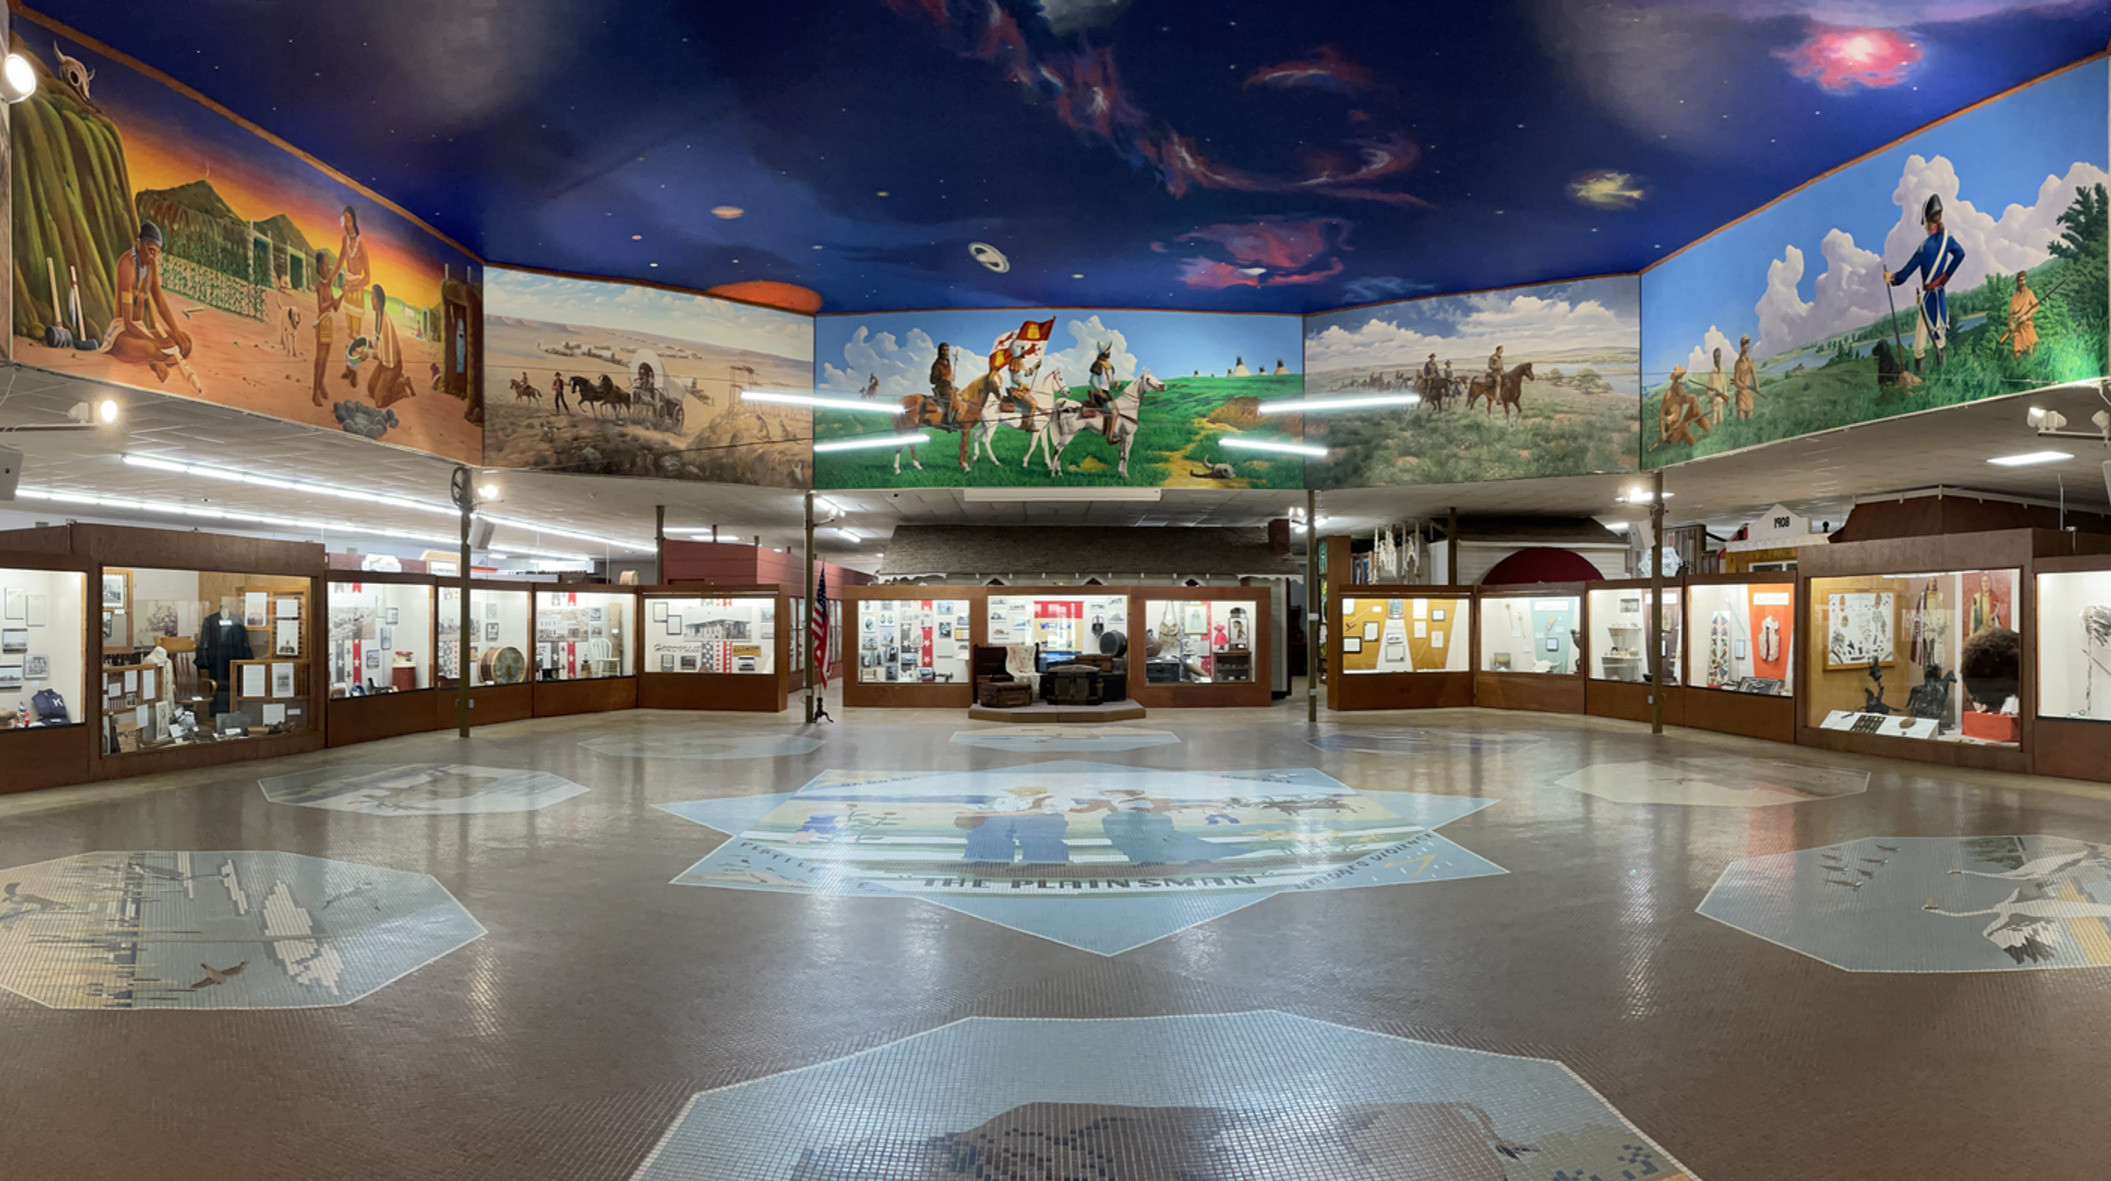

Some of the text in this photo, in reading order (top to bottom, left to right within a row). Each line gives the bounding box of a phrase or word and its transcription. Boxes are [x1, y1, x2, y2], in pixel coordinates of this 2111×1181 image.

[1774, 516, 1790, 528] 1908
[52, 698, 63, 707] K
[1370, 833, 1433, 861] VIOLENCE
